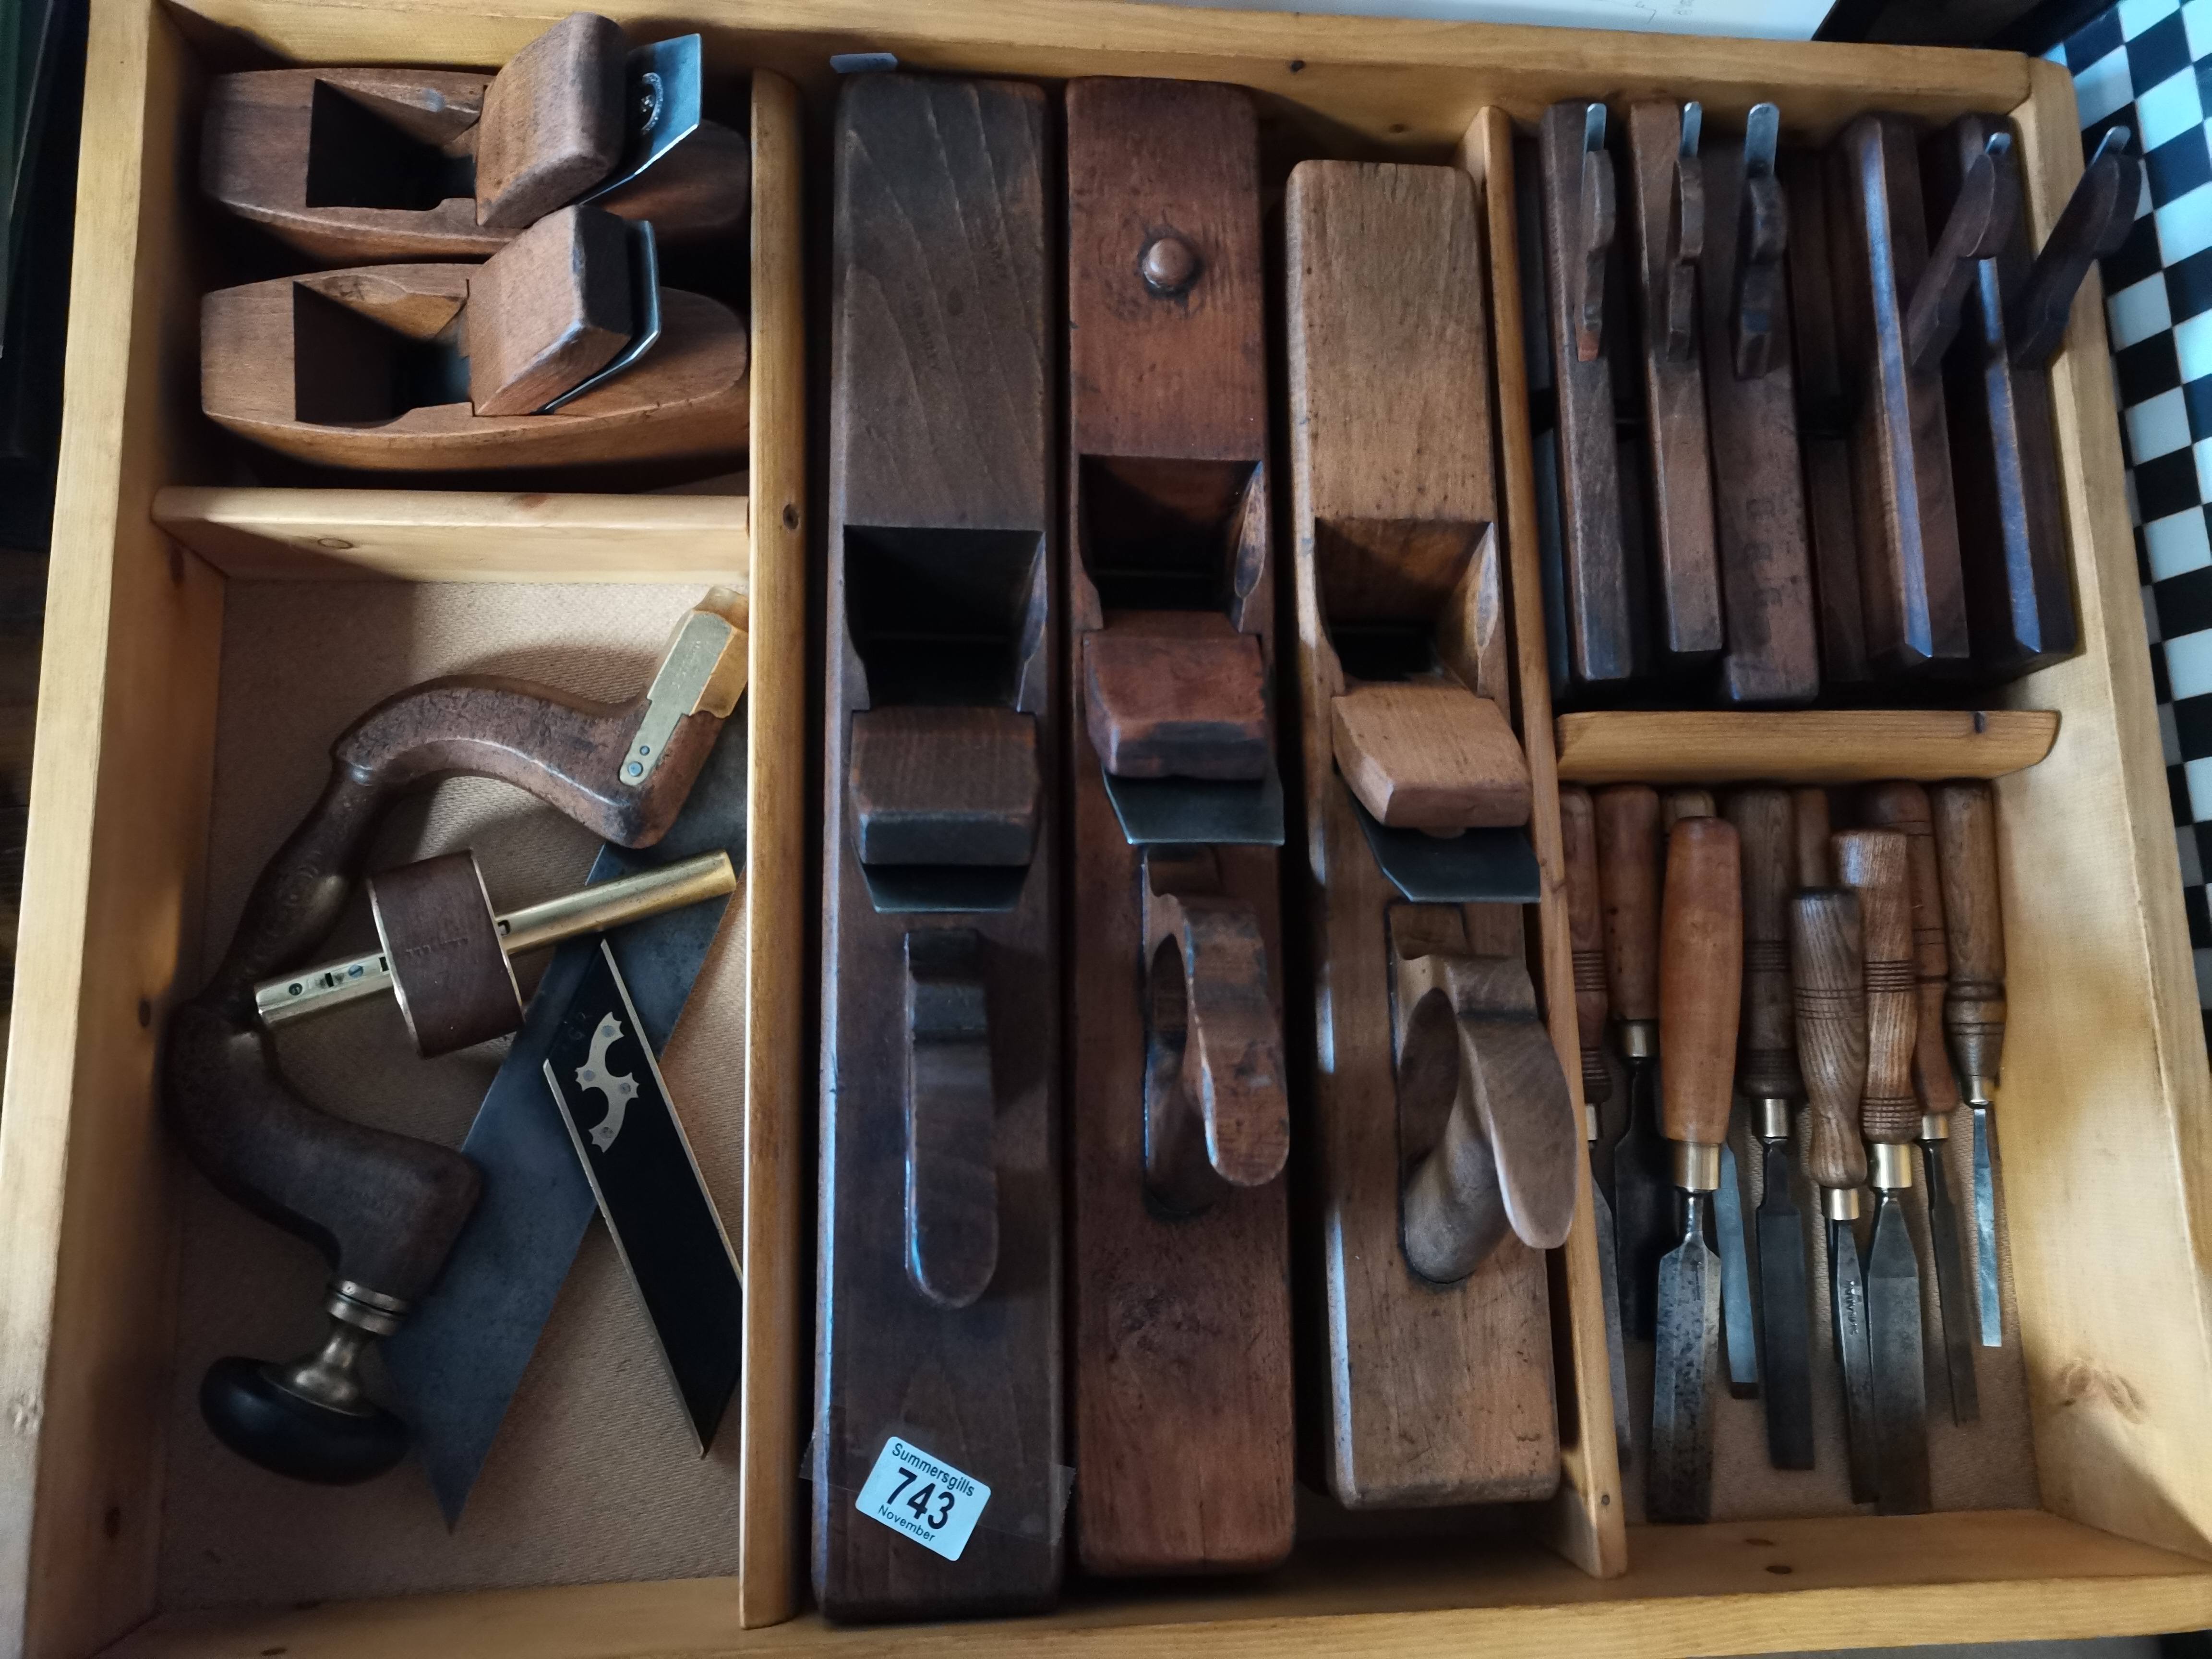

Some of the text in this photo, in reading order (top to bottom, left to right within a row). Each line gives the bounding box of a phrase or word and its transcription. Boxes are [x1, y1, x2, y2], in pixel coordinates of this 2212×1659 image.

[892, 1443, 975, 1497] Summersgills
[878, 1504, 936, 1542] November
[886, 1467, 955, 1530] 743
